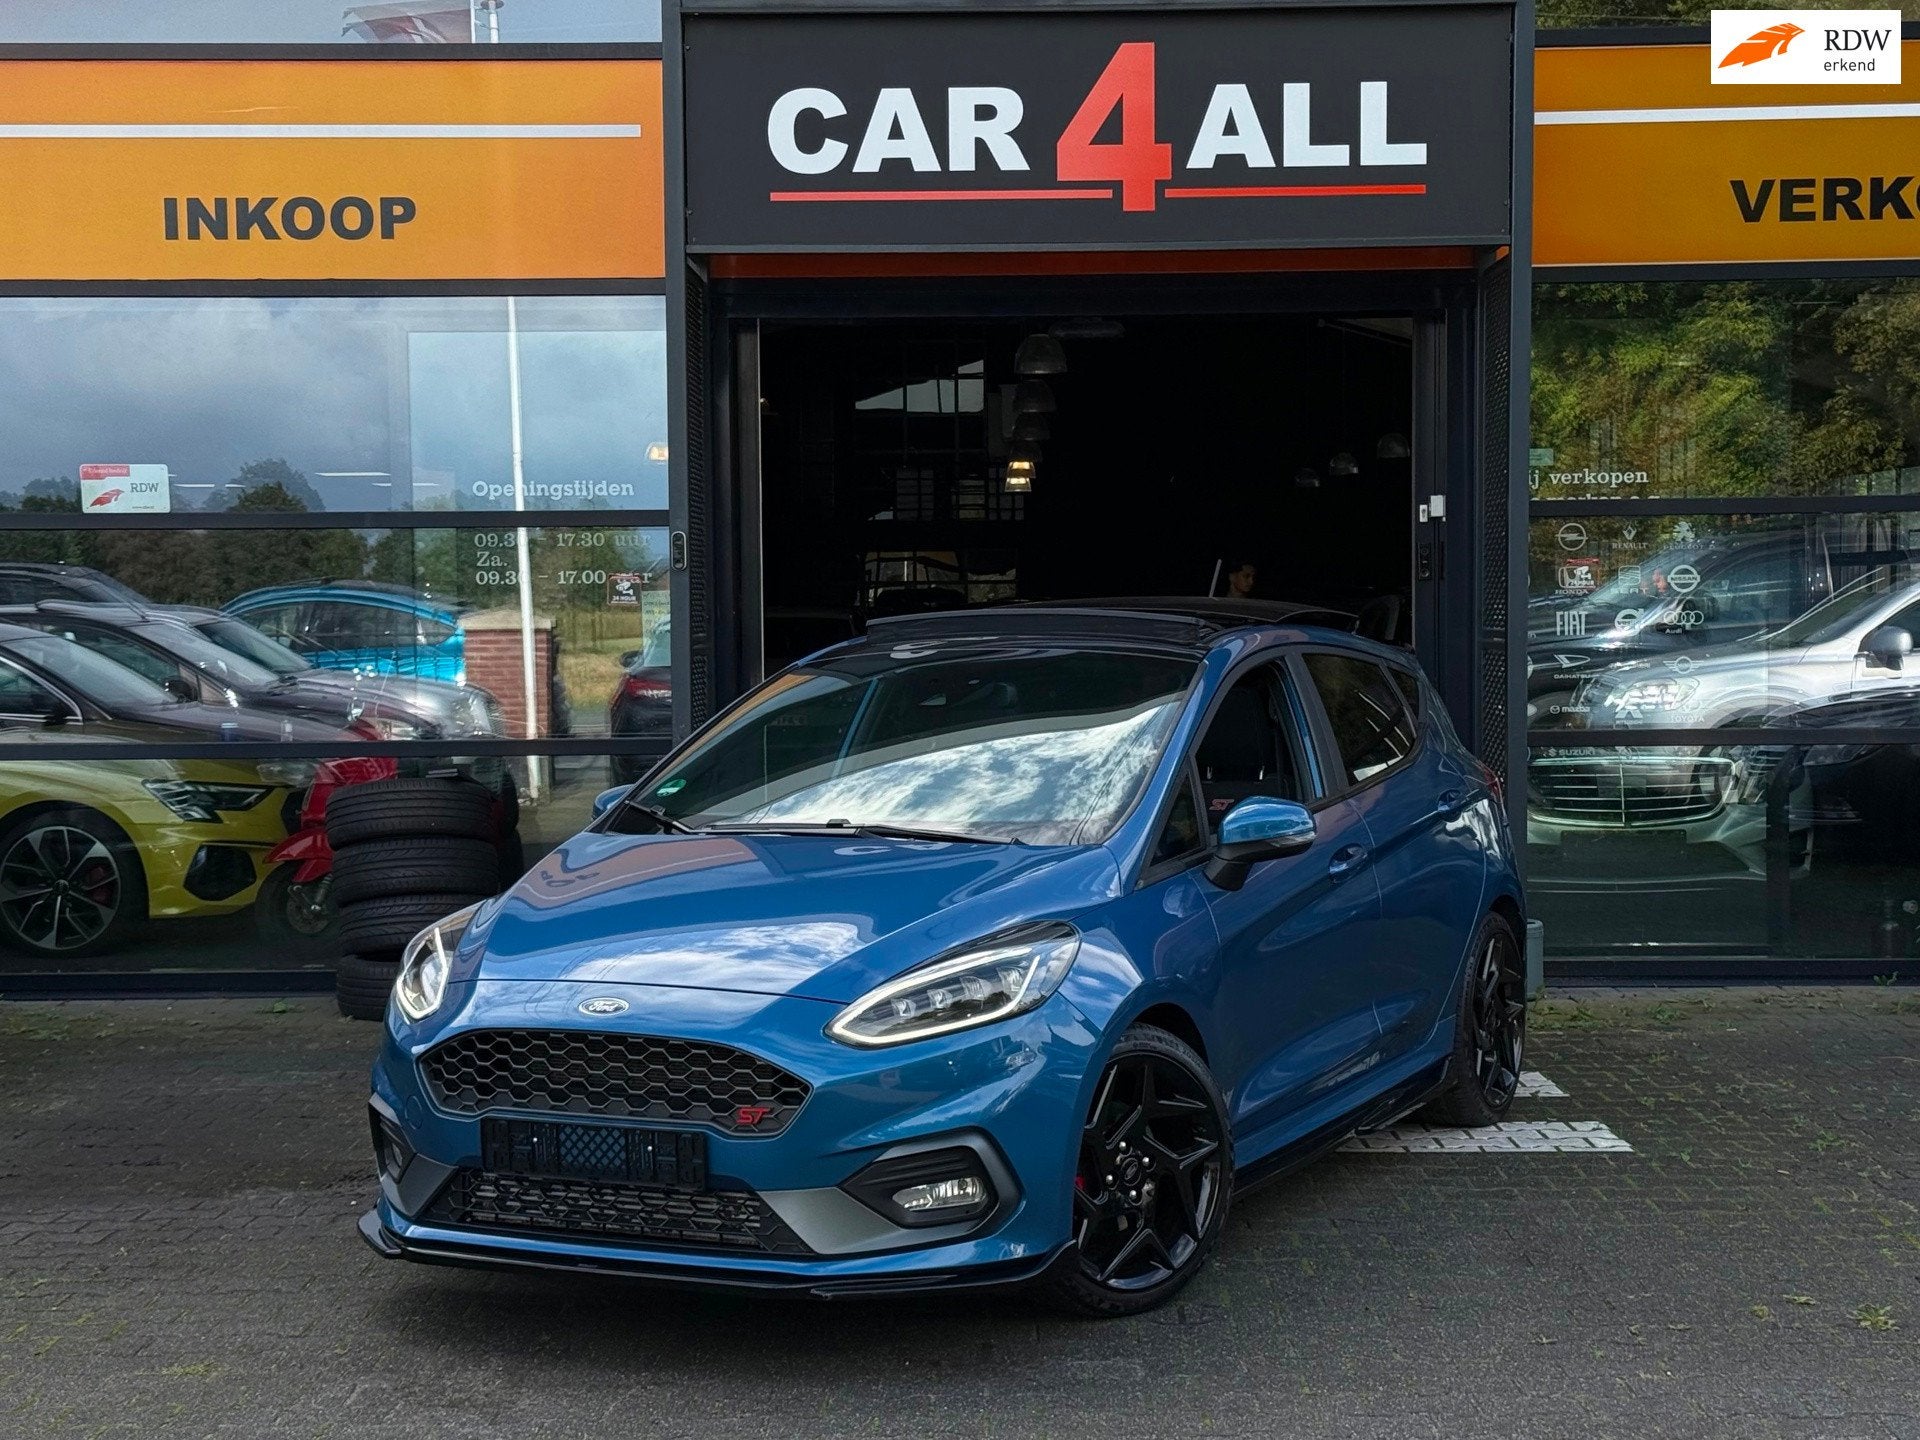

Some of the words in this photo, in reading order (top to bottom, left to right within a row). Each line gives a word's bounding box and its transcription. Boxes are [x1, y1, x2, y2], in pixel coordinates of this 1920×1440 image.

[767, 86, 1030, 174] CAR
[1056, 42, 1172, 212] 4
[1186, 81, 1428, 169] ALL
[1729, 176, 1920, 223] VERK
[164, 196, 417, 240] INKOOP
[129, 482, 160, 493] RDW
[1549, 468, 1649, 488] verkopen
[474, 532, 519, 548] 09.3
[556, 532, 605, 547] 17.30
[476, 551, 508, 567] Za.
[475, 570, 521, 585] 09.3
[557, 570, 607, 585] 17.00
[1555, 611, 1588, 636] FIAT
[588, 1000, 619, 1012] Ford
[736, 1105, 770, 1125] ST
